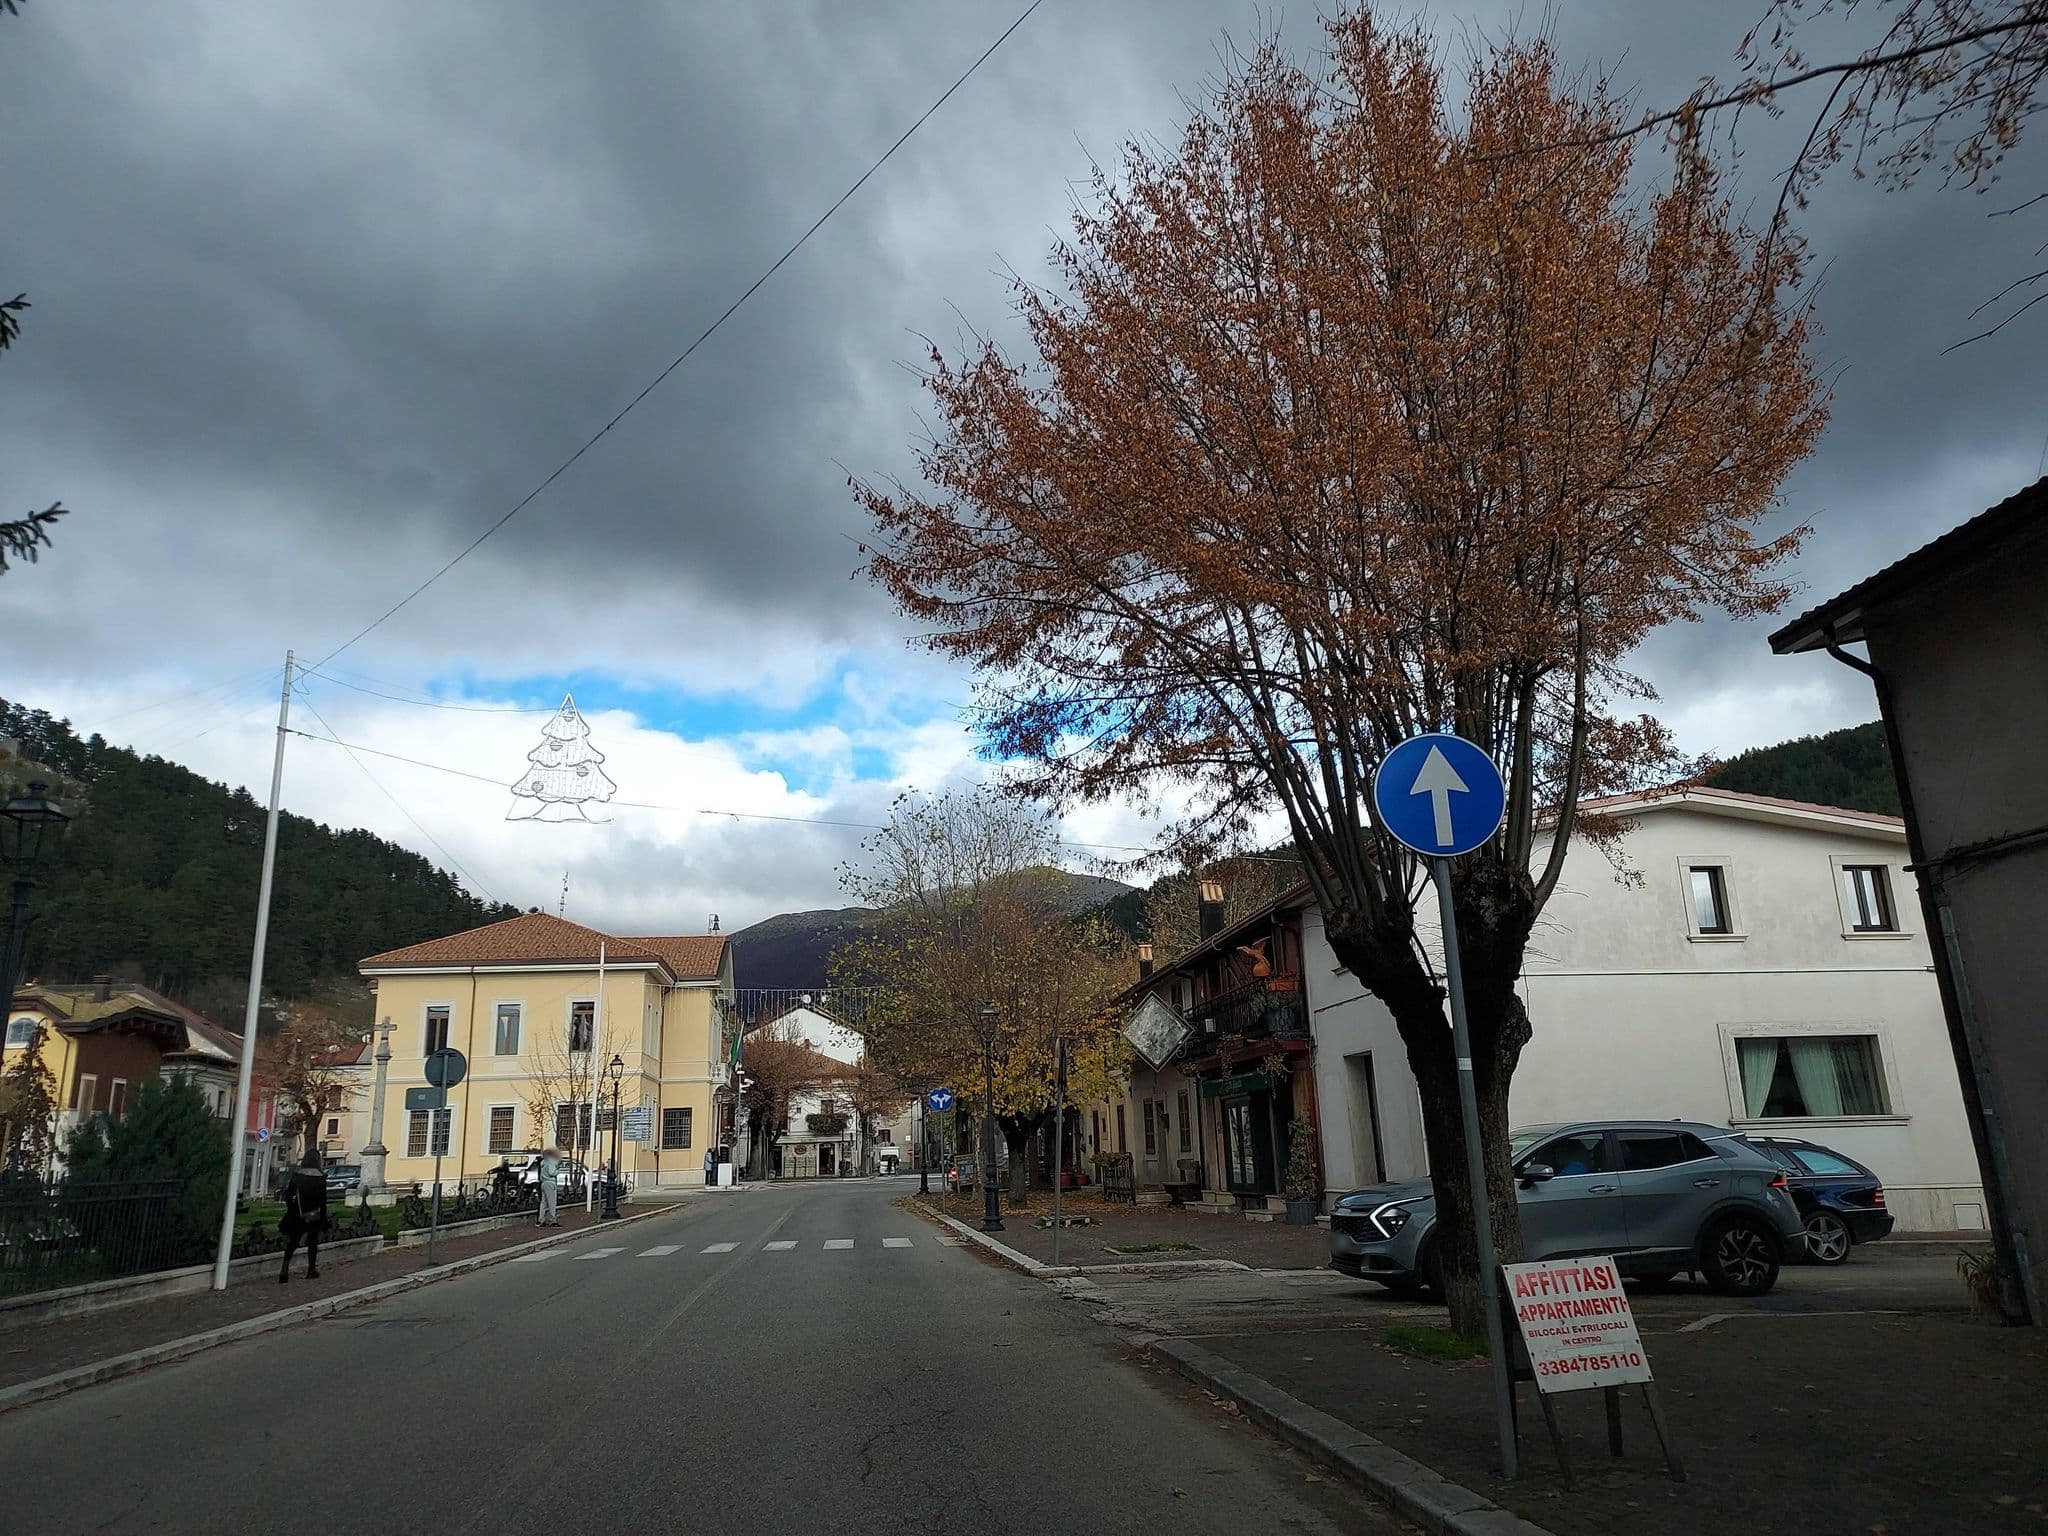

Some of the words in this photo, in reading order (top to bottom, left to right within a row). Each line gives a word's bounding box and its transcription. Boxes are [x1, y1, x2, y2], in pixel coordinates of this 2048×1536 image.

[1514, 1265, 1616, 1298] AFFITTASI
[1520, 1296, 1627, 1322] APPARTAMENTI
[1528, 1326, 1570, 1338] BILOCALI
[1572, 1325, 1580, 1334] E
[1581, 1321, 1629, 1333] TRILOCALI
[1562, 1338, 1571, 1346] IN
[1572, 1336, 1602, 1345] CENTRO
[1538, 1353, 1641, 1376] 3384785110
